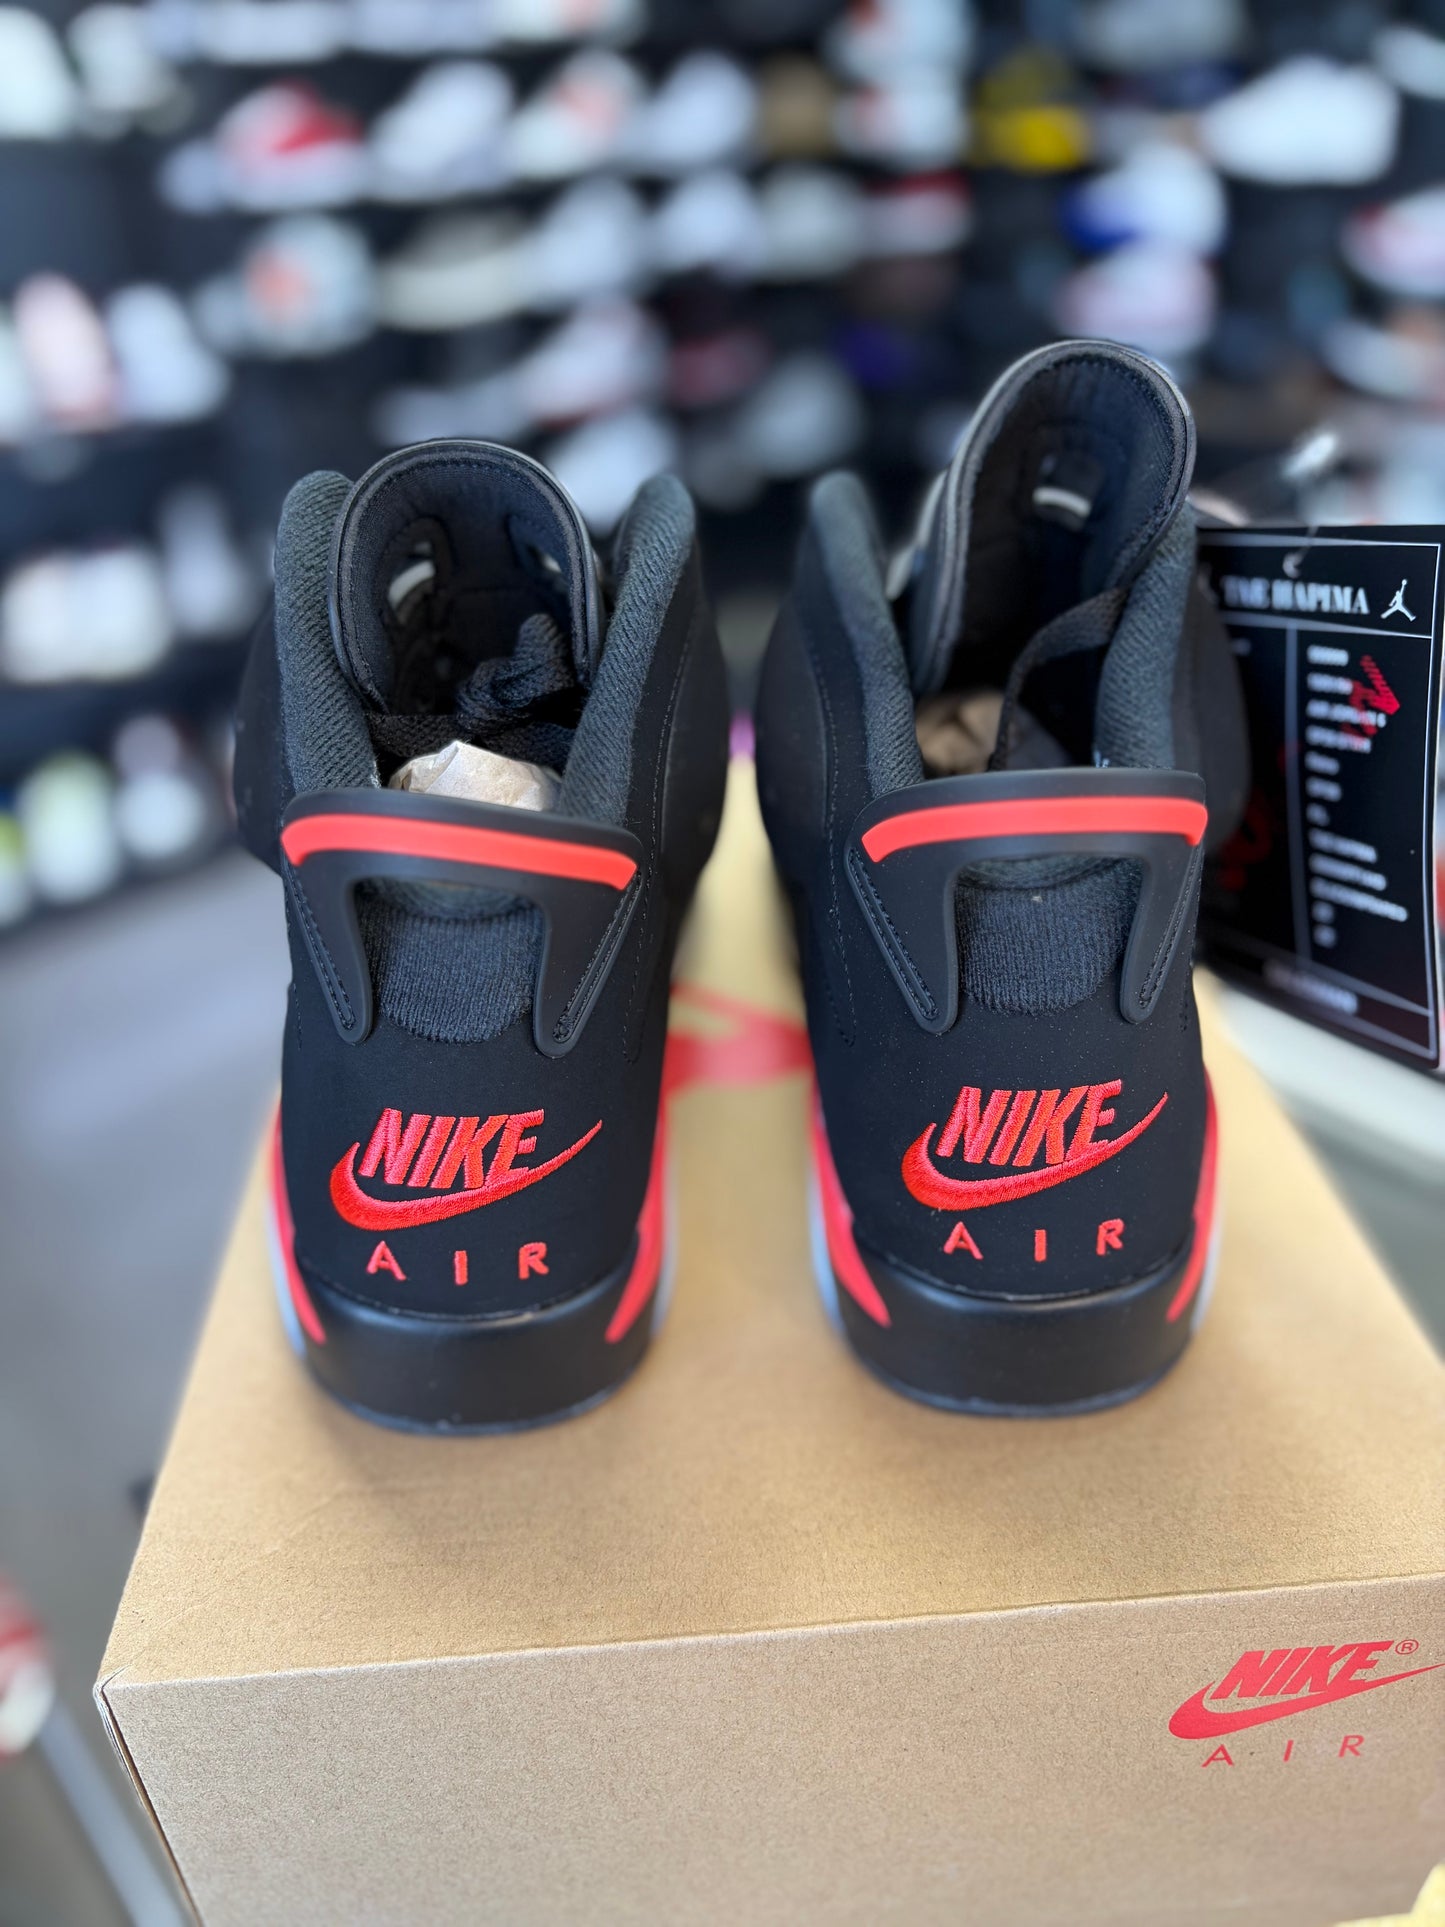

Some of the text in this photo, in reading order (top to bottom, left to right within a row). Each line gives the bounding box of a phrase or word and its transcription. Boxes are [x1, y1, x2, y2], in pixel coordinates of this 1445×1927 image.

[936, 1078, 1122, 1167] NIKE
[358, 1107, 544, 1189] NIKE
[366, 1240, 549, 1286] AIR
[943, 1219, 1125, 1263] AIR
[1201, 1734, 1365, 1768] AIR
